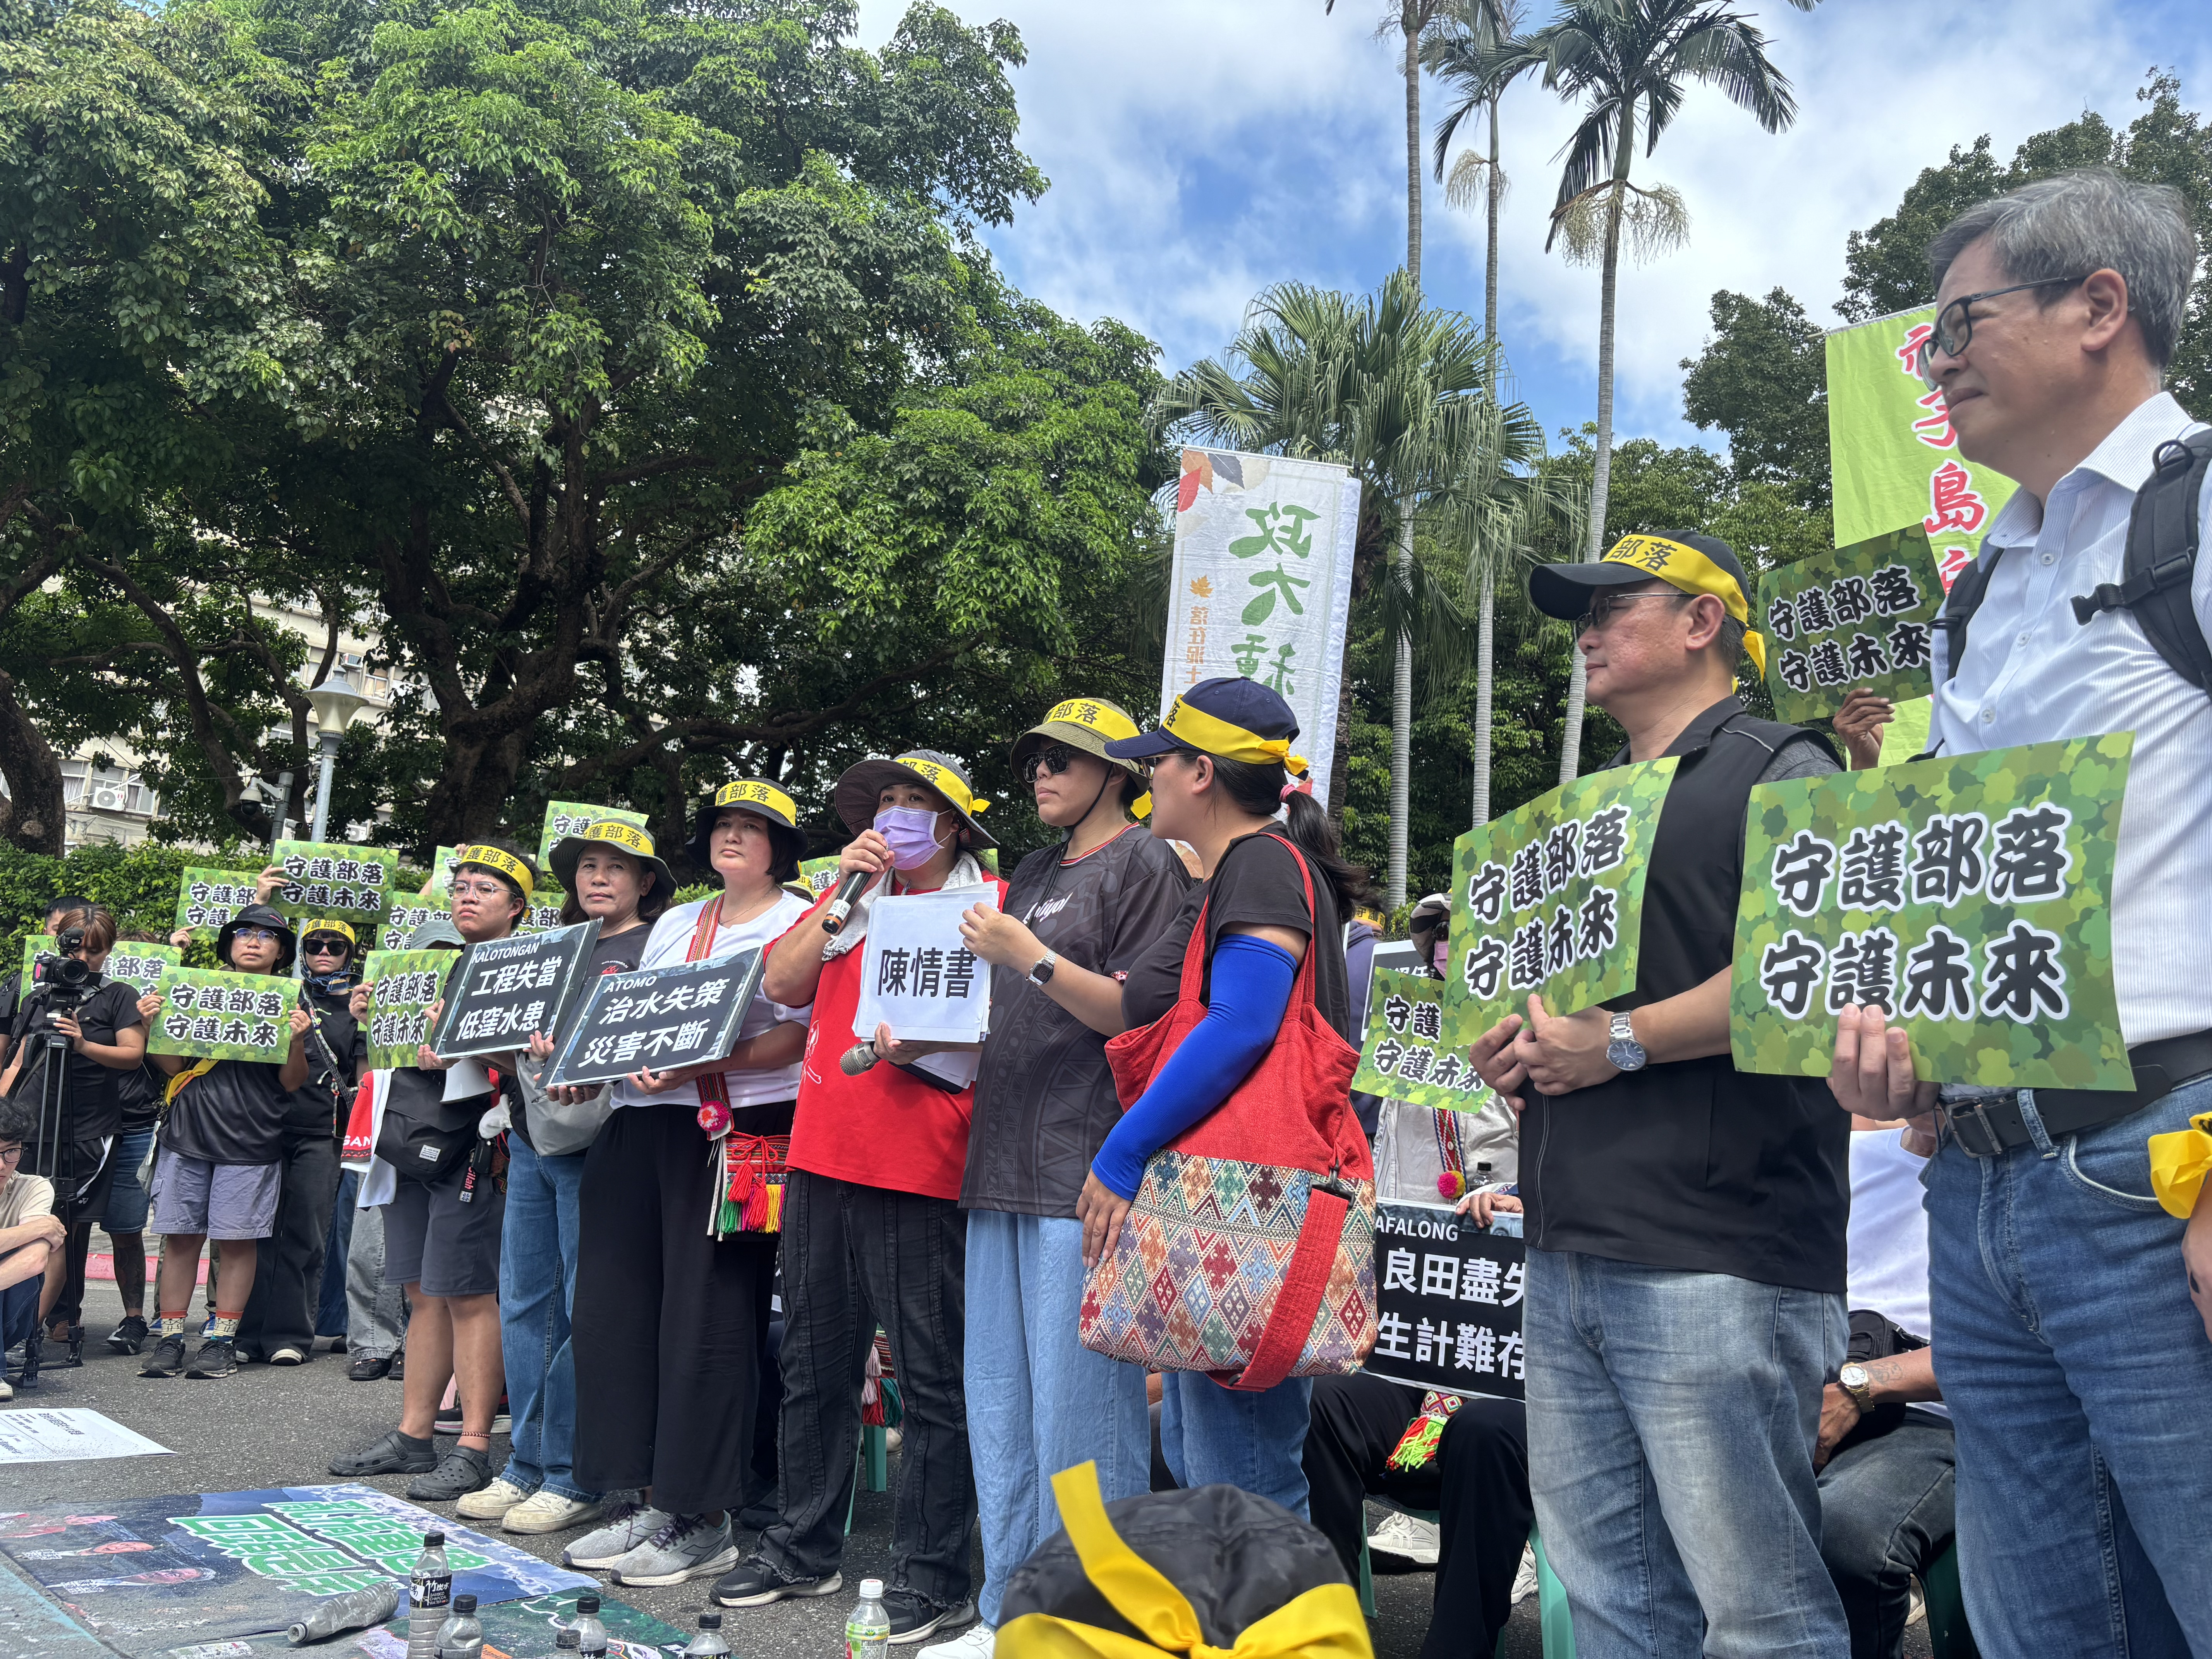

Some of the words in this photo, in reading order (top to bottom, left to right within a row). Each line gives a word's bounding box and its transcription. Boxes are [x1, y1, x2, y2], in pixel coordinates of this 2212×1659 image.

[1604, 538, 1678, 571] 部落
[1769, 565, 1921, 640] 守護部落
[1779, 623, 1930, 691] 守護未來
[285, 854, 384, 884] 守護部落
[466, 847, 519, 873] 護部落
[812, 870, 839, 890] 護
[1470, 805, 1630, 923] 守護部落
[1774, 805, 2070, 915] 守護部落
[282, 882, 381, 910] 守護未來
[471, 942, 540, 963] KALOTONGAN
[1465, 886, 1617, 999] 守護未來
[375, 970, 439, 1010] 守護部落
[471, 956, 562, 997] 工程失當
[603, 975, 657, 994] ATOMO
[878, 947, 977, 998] 陳情書
[1762, 921, 2068, 1022] 守護未來
[172, 984, 283, 1017] 守護部落
[455, 1000, 545, 1041] 低窪水患
[598, 978, 730, 1025] 治水失策
[1385, 995, 1441, 1042] 守護
[165, 1013, 279, 1047] 守護未來
[371, 1010, 427, 1047] 守護未來
[578, 1018, 711, 1067] 災害不斷
[1376, 1215, 1458, 1241] AFALONG
[1383, 1247, 1525, 1307] 良田盡失
[1374, 1312, 1525, 1379] 生計難存
